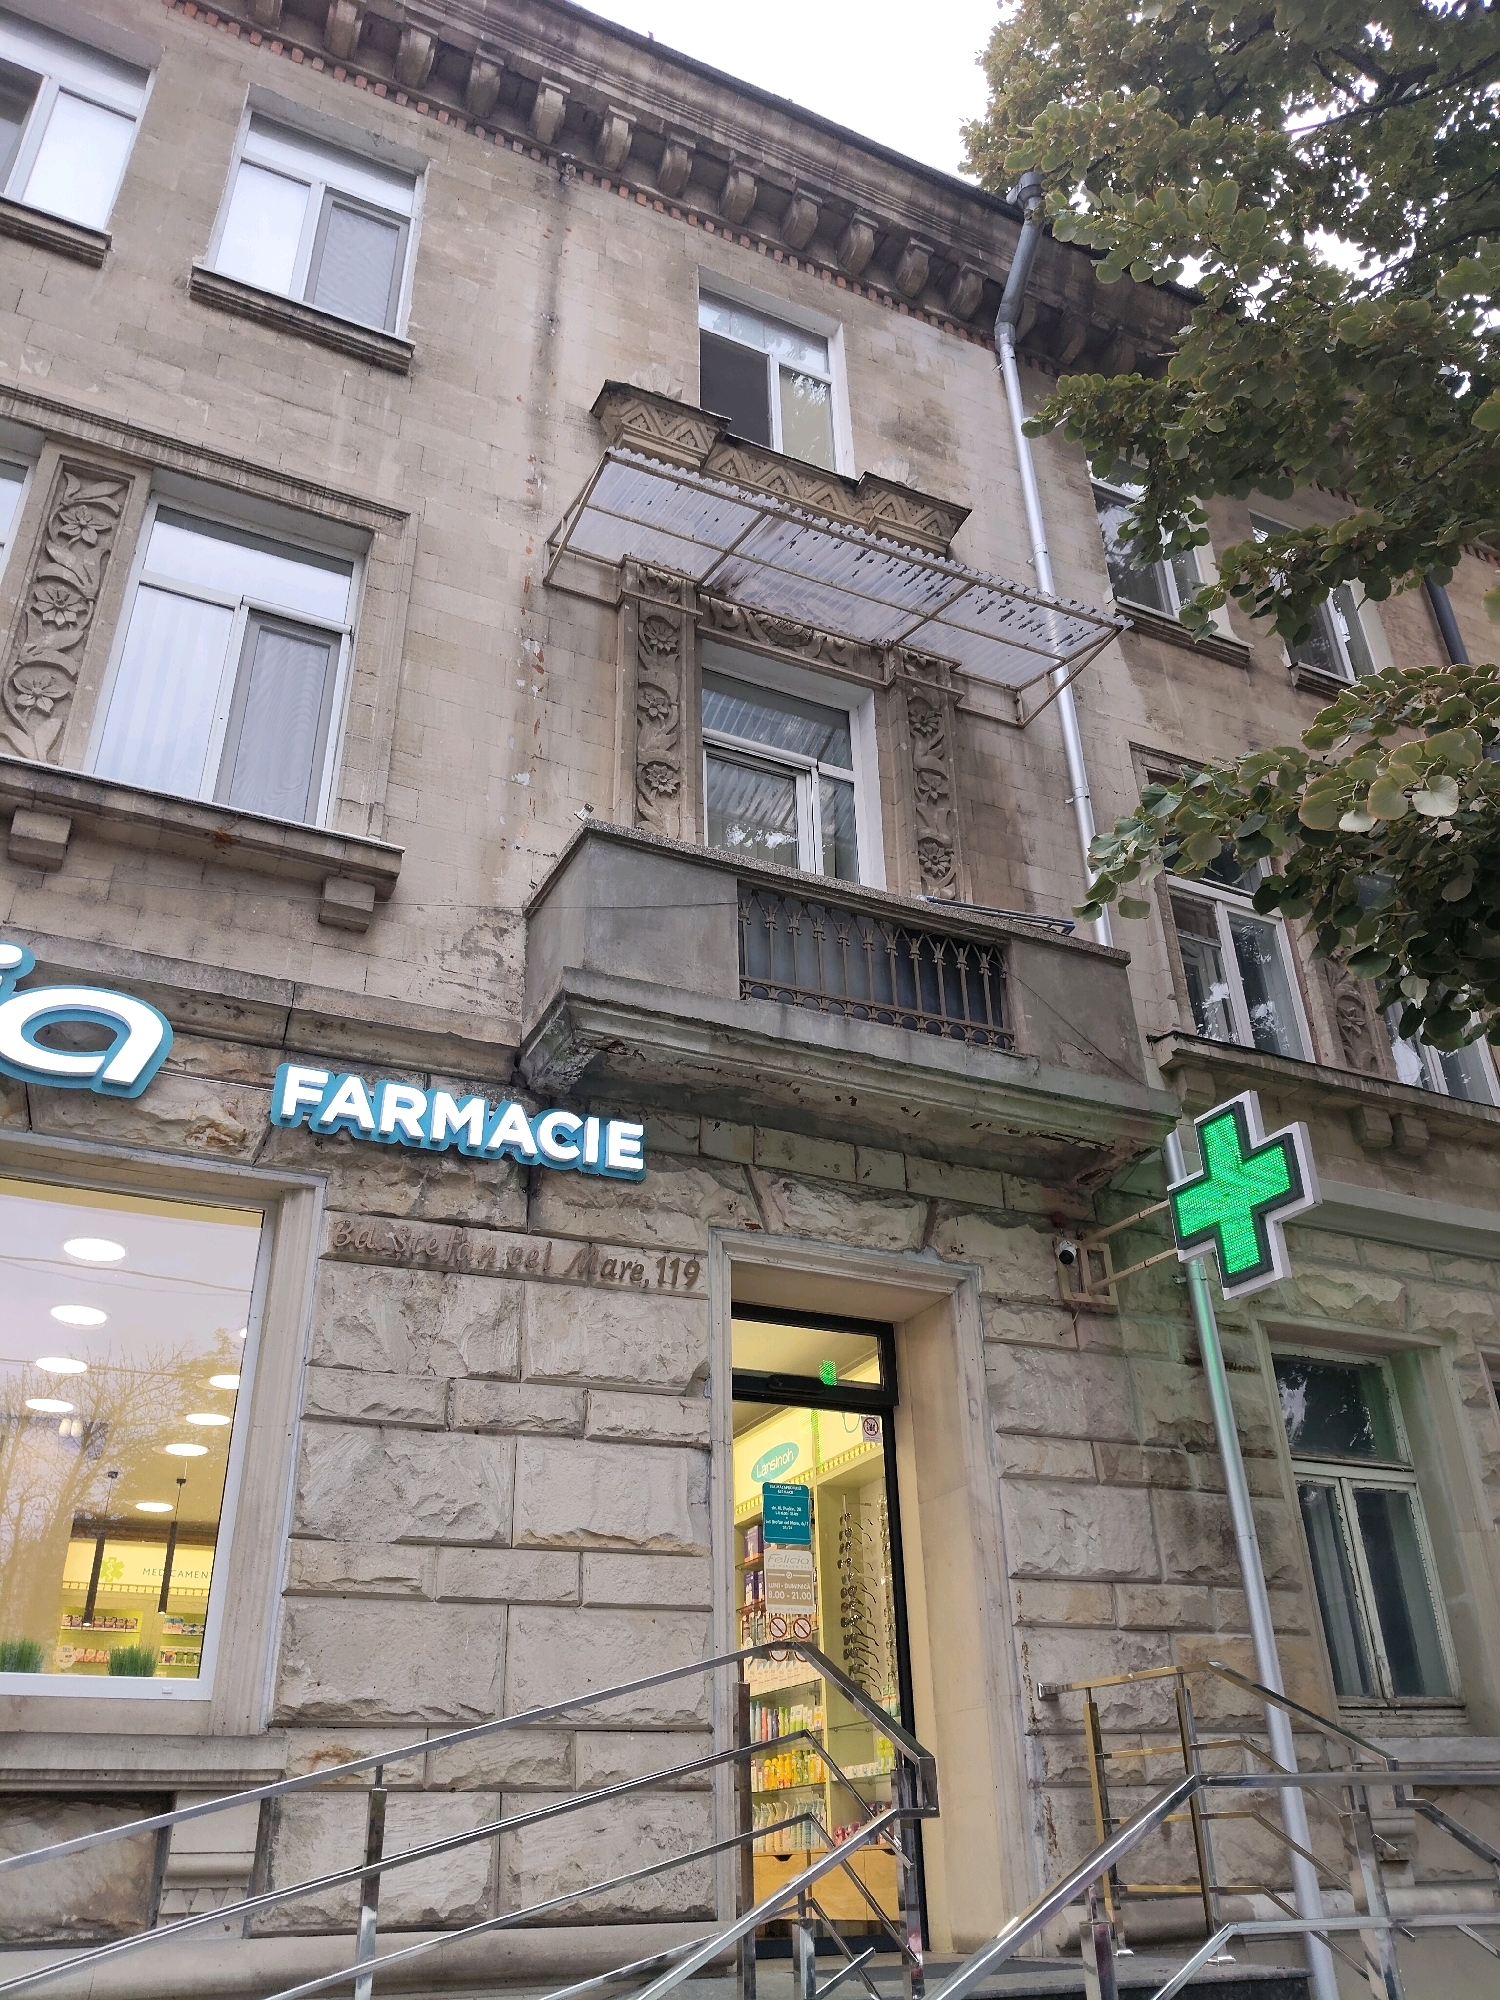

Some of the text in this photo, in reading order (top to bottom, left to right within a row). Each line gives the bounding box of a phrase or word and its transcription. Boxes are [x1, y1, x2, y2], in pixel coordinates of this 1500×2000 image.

[280, 1066, 646, 1171] FARMACIE
[655, 1255, 701, 1288] 119
[756, 1447, 794, 1479] Lansinoh
[768, 1554, 810, 1565] Felicia
[142, 1568, 213, 1579] MEDCAMEN
[768, 1590, 785, 1599] 8.00
[791, 1591, 812, 1600] 21.00
